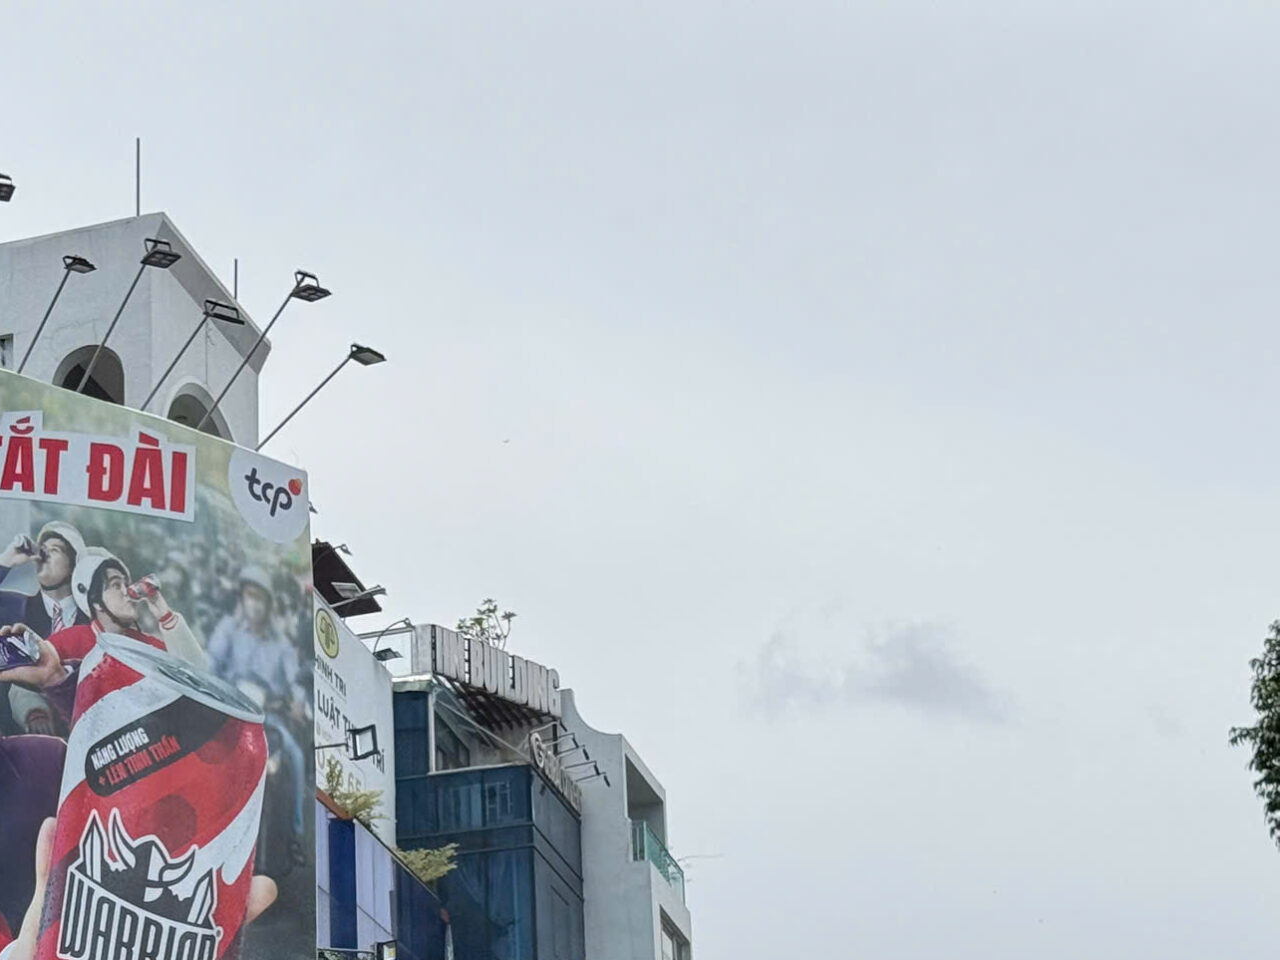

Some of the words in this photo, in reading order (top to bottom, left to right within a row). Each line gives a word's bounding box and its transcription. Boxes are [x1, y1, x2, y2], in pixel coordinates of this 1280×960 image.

[86, 431, 188, 514] ĐÀI
[244, 467, 293, 518] tcp
[470, 638, 561, 718] BUILDING
[91, 747, 119, 771] NĂNG
[114, 727, 150, 757] LƯỢNG
